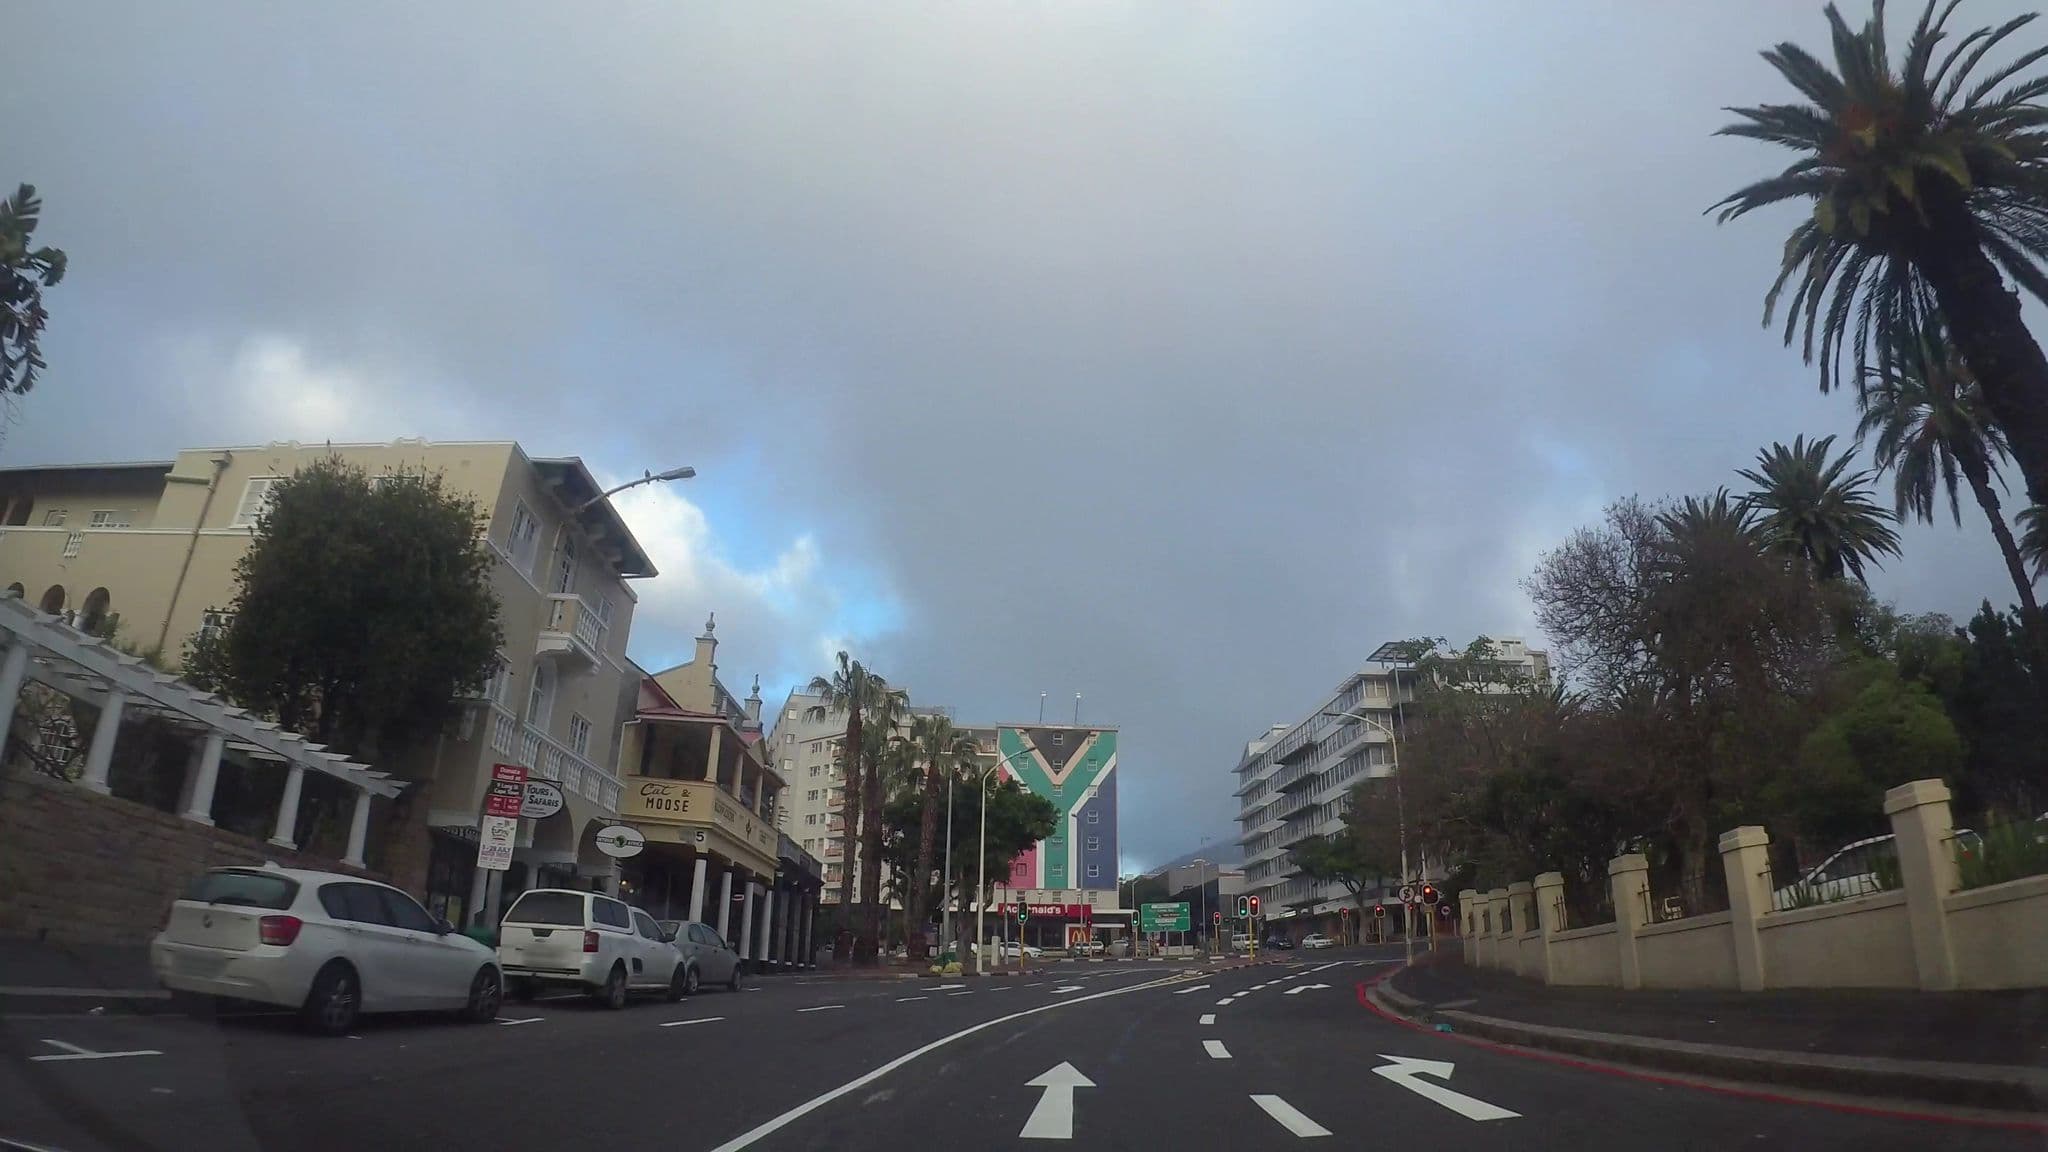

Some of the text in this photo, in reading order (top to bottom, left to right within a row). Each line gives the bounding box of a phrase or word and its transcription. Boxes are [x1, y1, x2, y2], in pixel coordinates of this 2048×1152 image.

[527, 785, 549, 796] TOURS
[640, 783, 691, 797] Cat &
[528, 795, 559, 807] SAFARIS
[646, 797, 689, 812] MOOSE
[1002, 905, 1061, 914] Mcnald's
